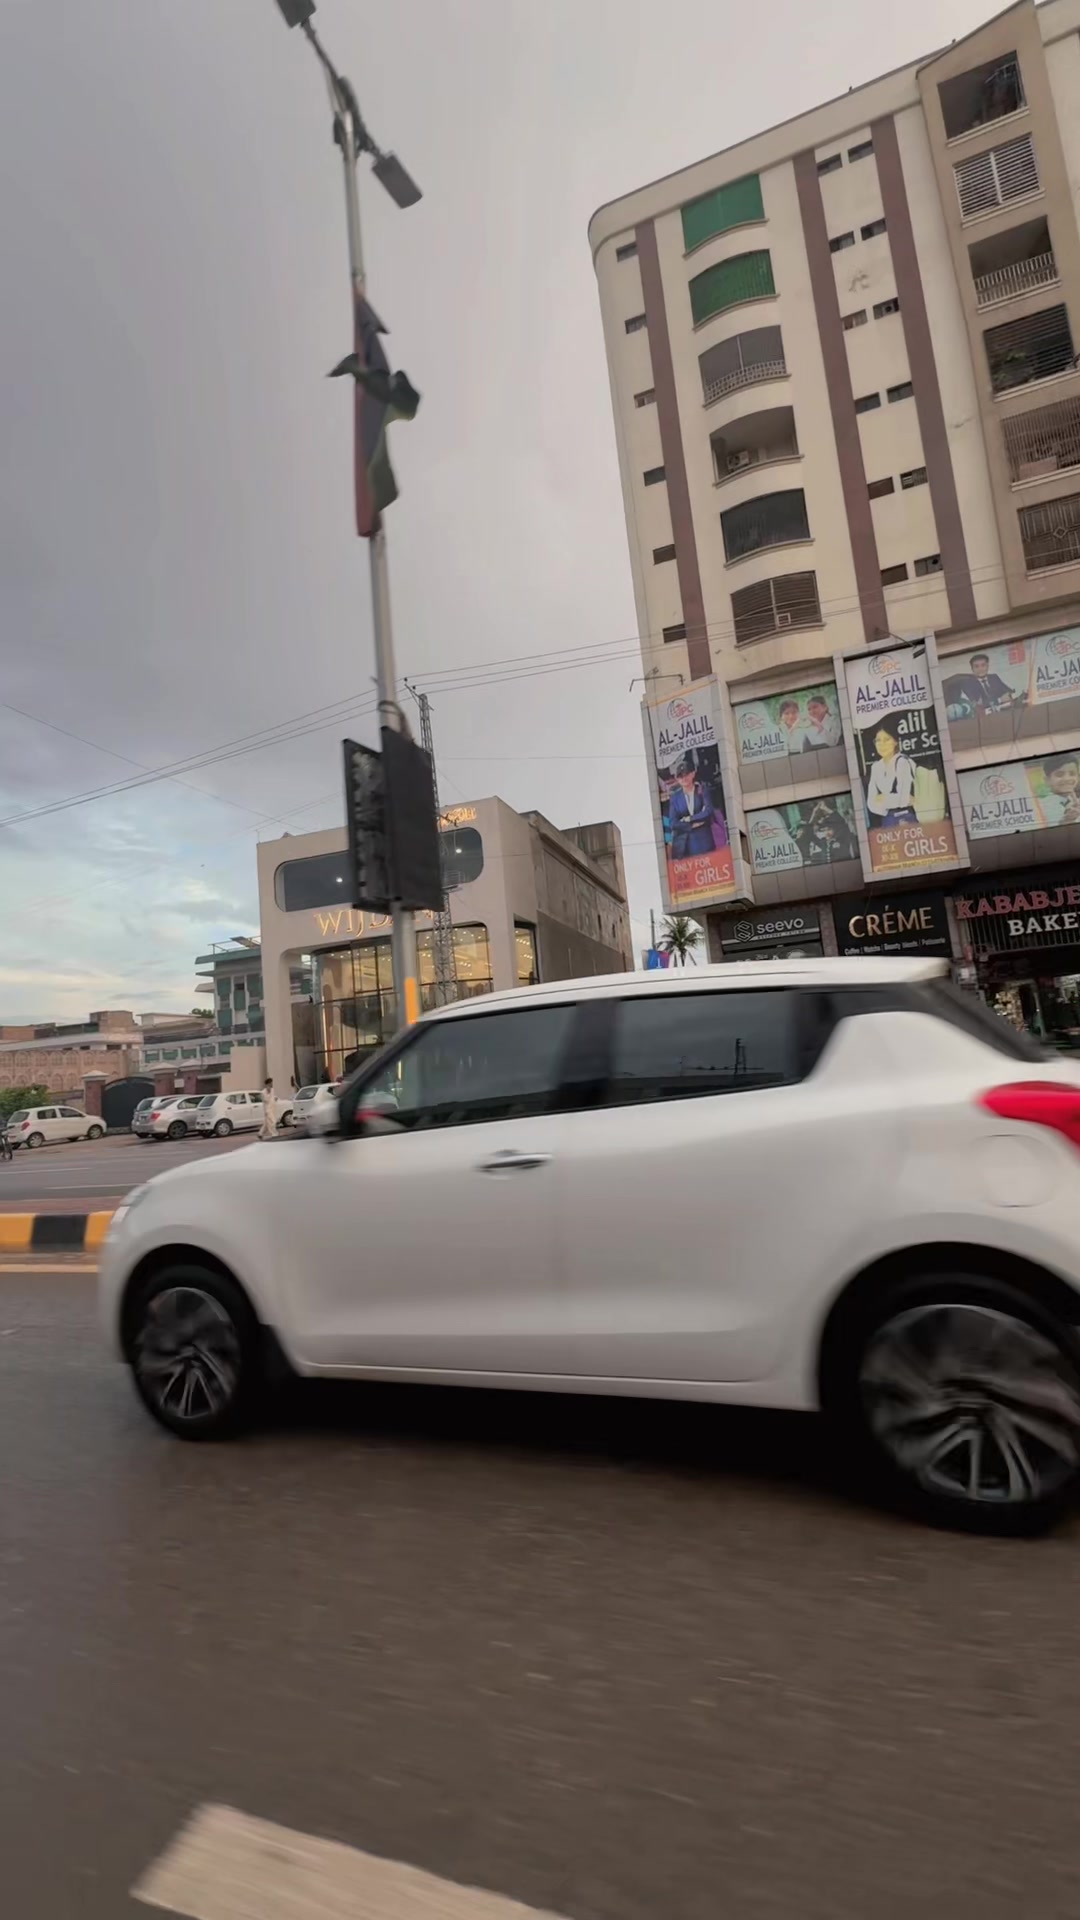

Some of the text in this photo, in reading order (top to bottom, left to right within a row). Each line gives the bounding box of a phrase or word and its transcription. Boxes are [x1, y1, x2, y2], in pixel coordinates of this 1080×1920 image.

[856, 674, 925, 704] AL-JALIL
[856, 692, 927, 714] PREMIER COLLEGE
[659, 715, 713, 748] AL-JALIL
[897, 710, 927, 735] alil
[659, 731, 715, 757] PREMIER COLLEGE
[742, 732, 784, 752] AL-JALIL
[970, 797, 1033, 822] AL-JALIL
[971, 814, 1035, 831] PREMIER SCHOOL
[876, 827, 924, 843] ONLY FOR
[755, 842, 798, 861] AL-JALIL
[904, 836, 948, 857] GIRLS
[674, 857, 711, 873] ONLY FOR
[756, 855, 800, 868] PREMIER COLLEGE
[695, 864, 730, 885] GIRLS
[955, 884, 1080, 919] KABABJE
[756, 918, 804, 934] seevo
[849, 905, 934, 938] CRÉME
